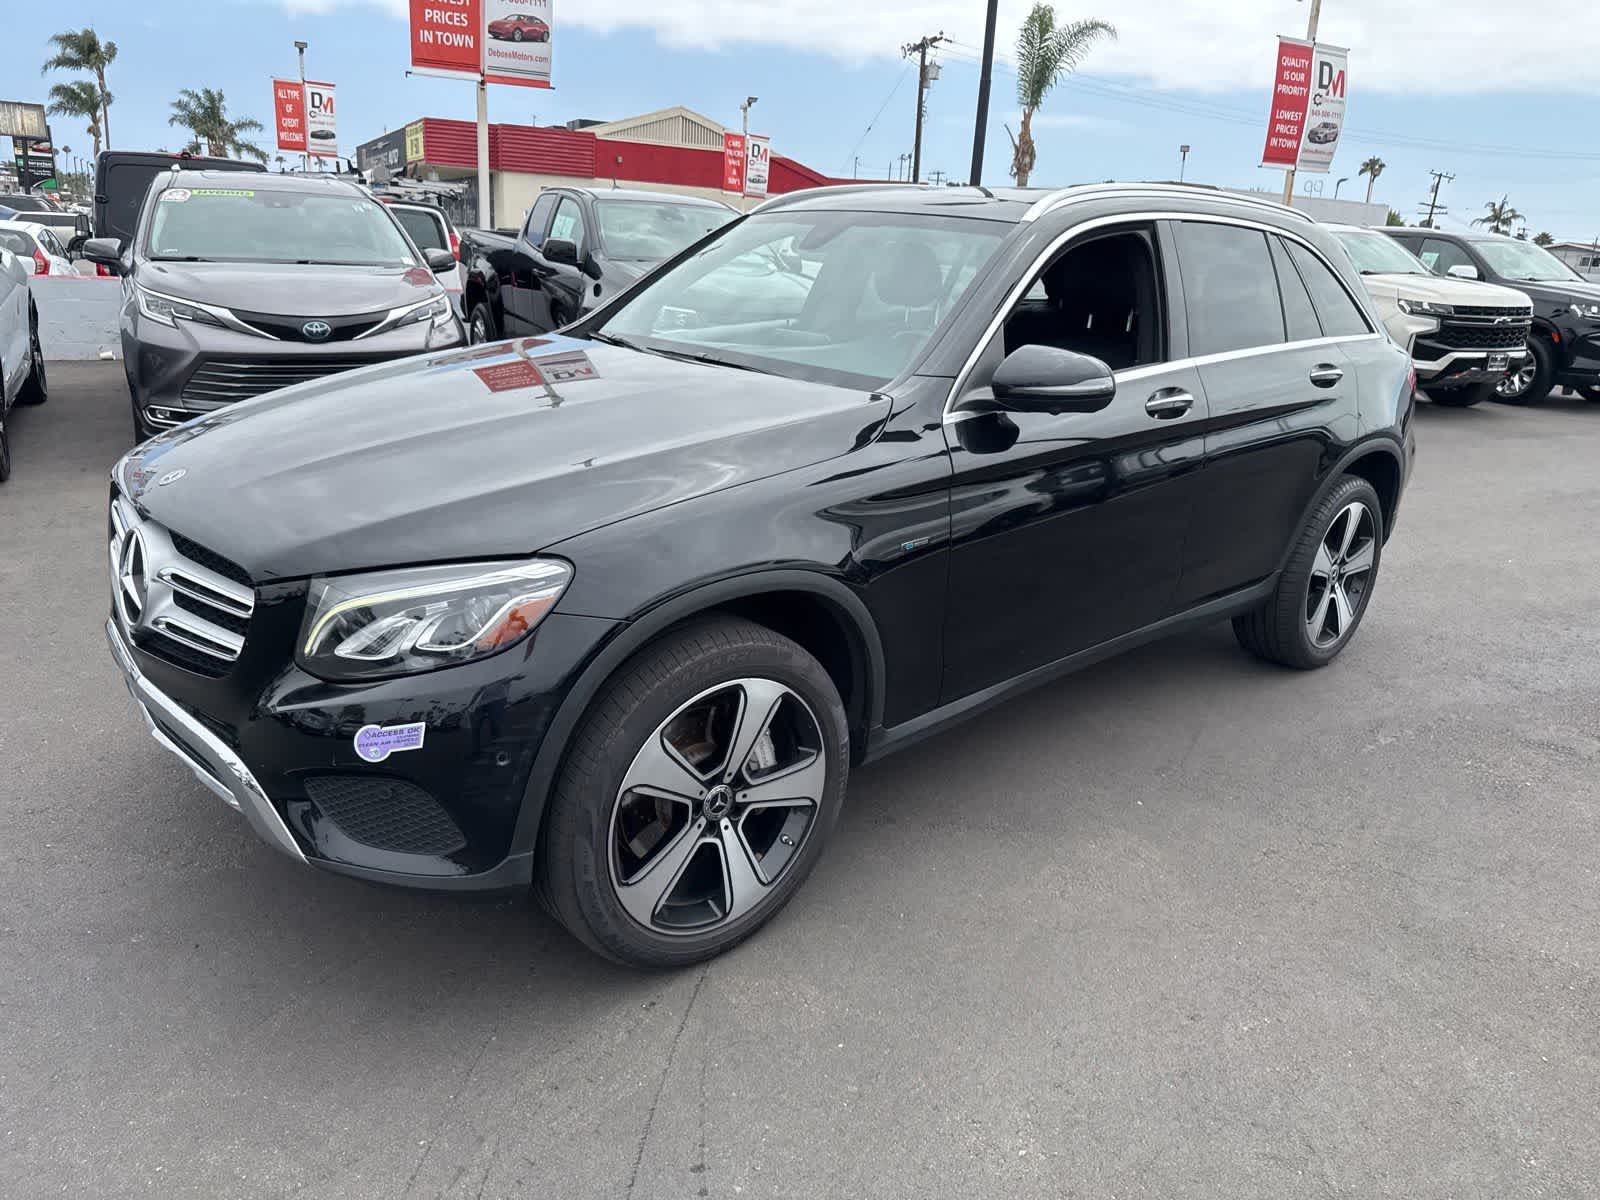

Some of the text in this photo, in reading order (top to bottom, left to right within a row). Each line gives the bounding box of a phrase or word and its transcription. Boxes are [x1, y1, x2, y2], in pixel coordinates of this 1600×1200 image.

[424, 8, 468, 27] PRICES
[420, 29, 474, 49] IN TOWN
[1281, 56, 1309, 69] QUALITY
[1283, 70, 1305, 82] IS OUR
[1277, 84, 1308, 97] PRIORITY
[1276, 109, 1303, 121] LOWEST
[1275, 123, 1299, 135] PRICES
[1269, 137, 1298, 150] IN TOWN
[371, 729, 404, 738] ACCESS
